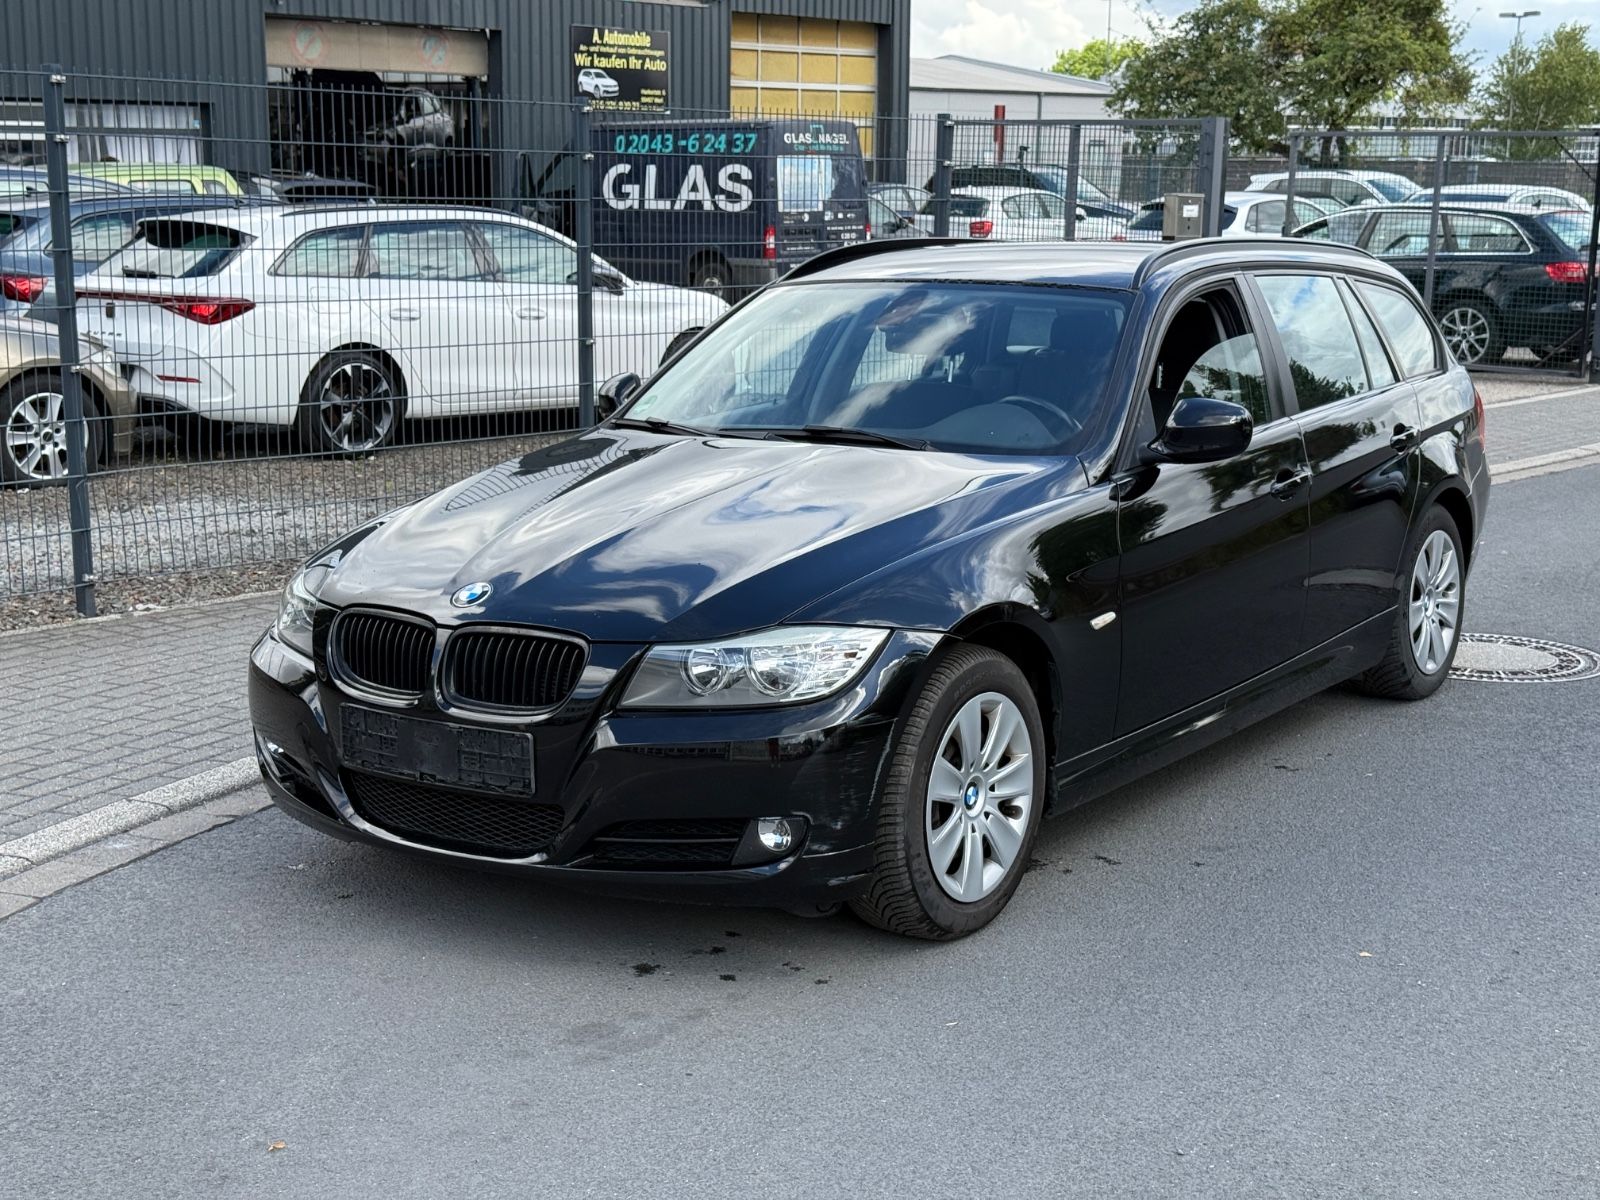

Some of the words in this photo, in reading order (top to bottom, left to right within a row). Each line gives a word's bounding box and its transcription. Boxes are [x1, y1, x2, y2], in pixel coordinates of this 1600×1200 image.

[592, 28, 602, 44] A.
[603, 29, 651, 47] Automobile
[574, 53, 592, 66] Wir
[593, 54, 627, 69] kaufen
[629, 56, 642, 69] Ihr
[644, 57, 667, 71] Auto
[783, 132, 812, 144] GLAS
[602, 163, 753, 212] GLAS
